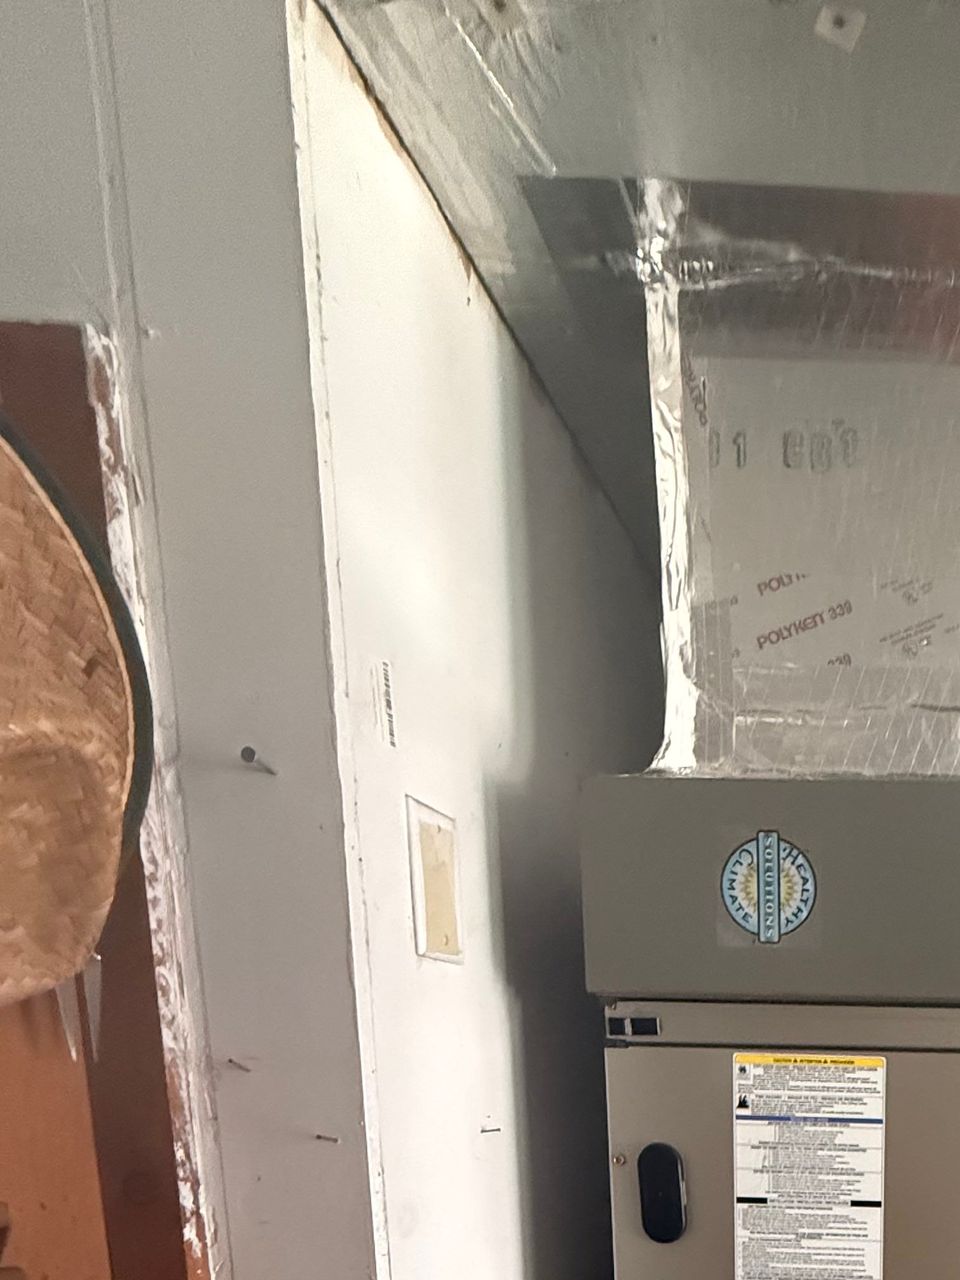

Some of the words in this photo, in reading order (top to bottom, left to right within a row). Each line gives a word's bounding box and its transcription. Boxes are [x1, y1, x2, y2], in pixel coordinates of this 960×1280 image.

[727, 848, 754, 924] CLIMATE
[764, 834, 775, 938] SOLUTIONS
[782, 846, 810, 928] HEALTHY
